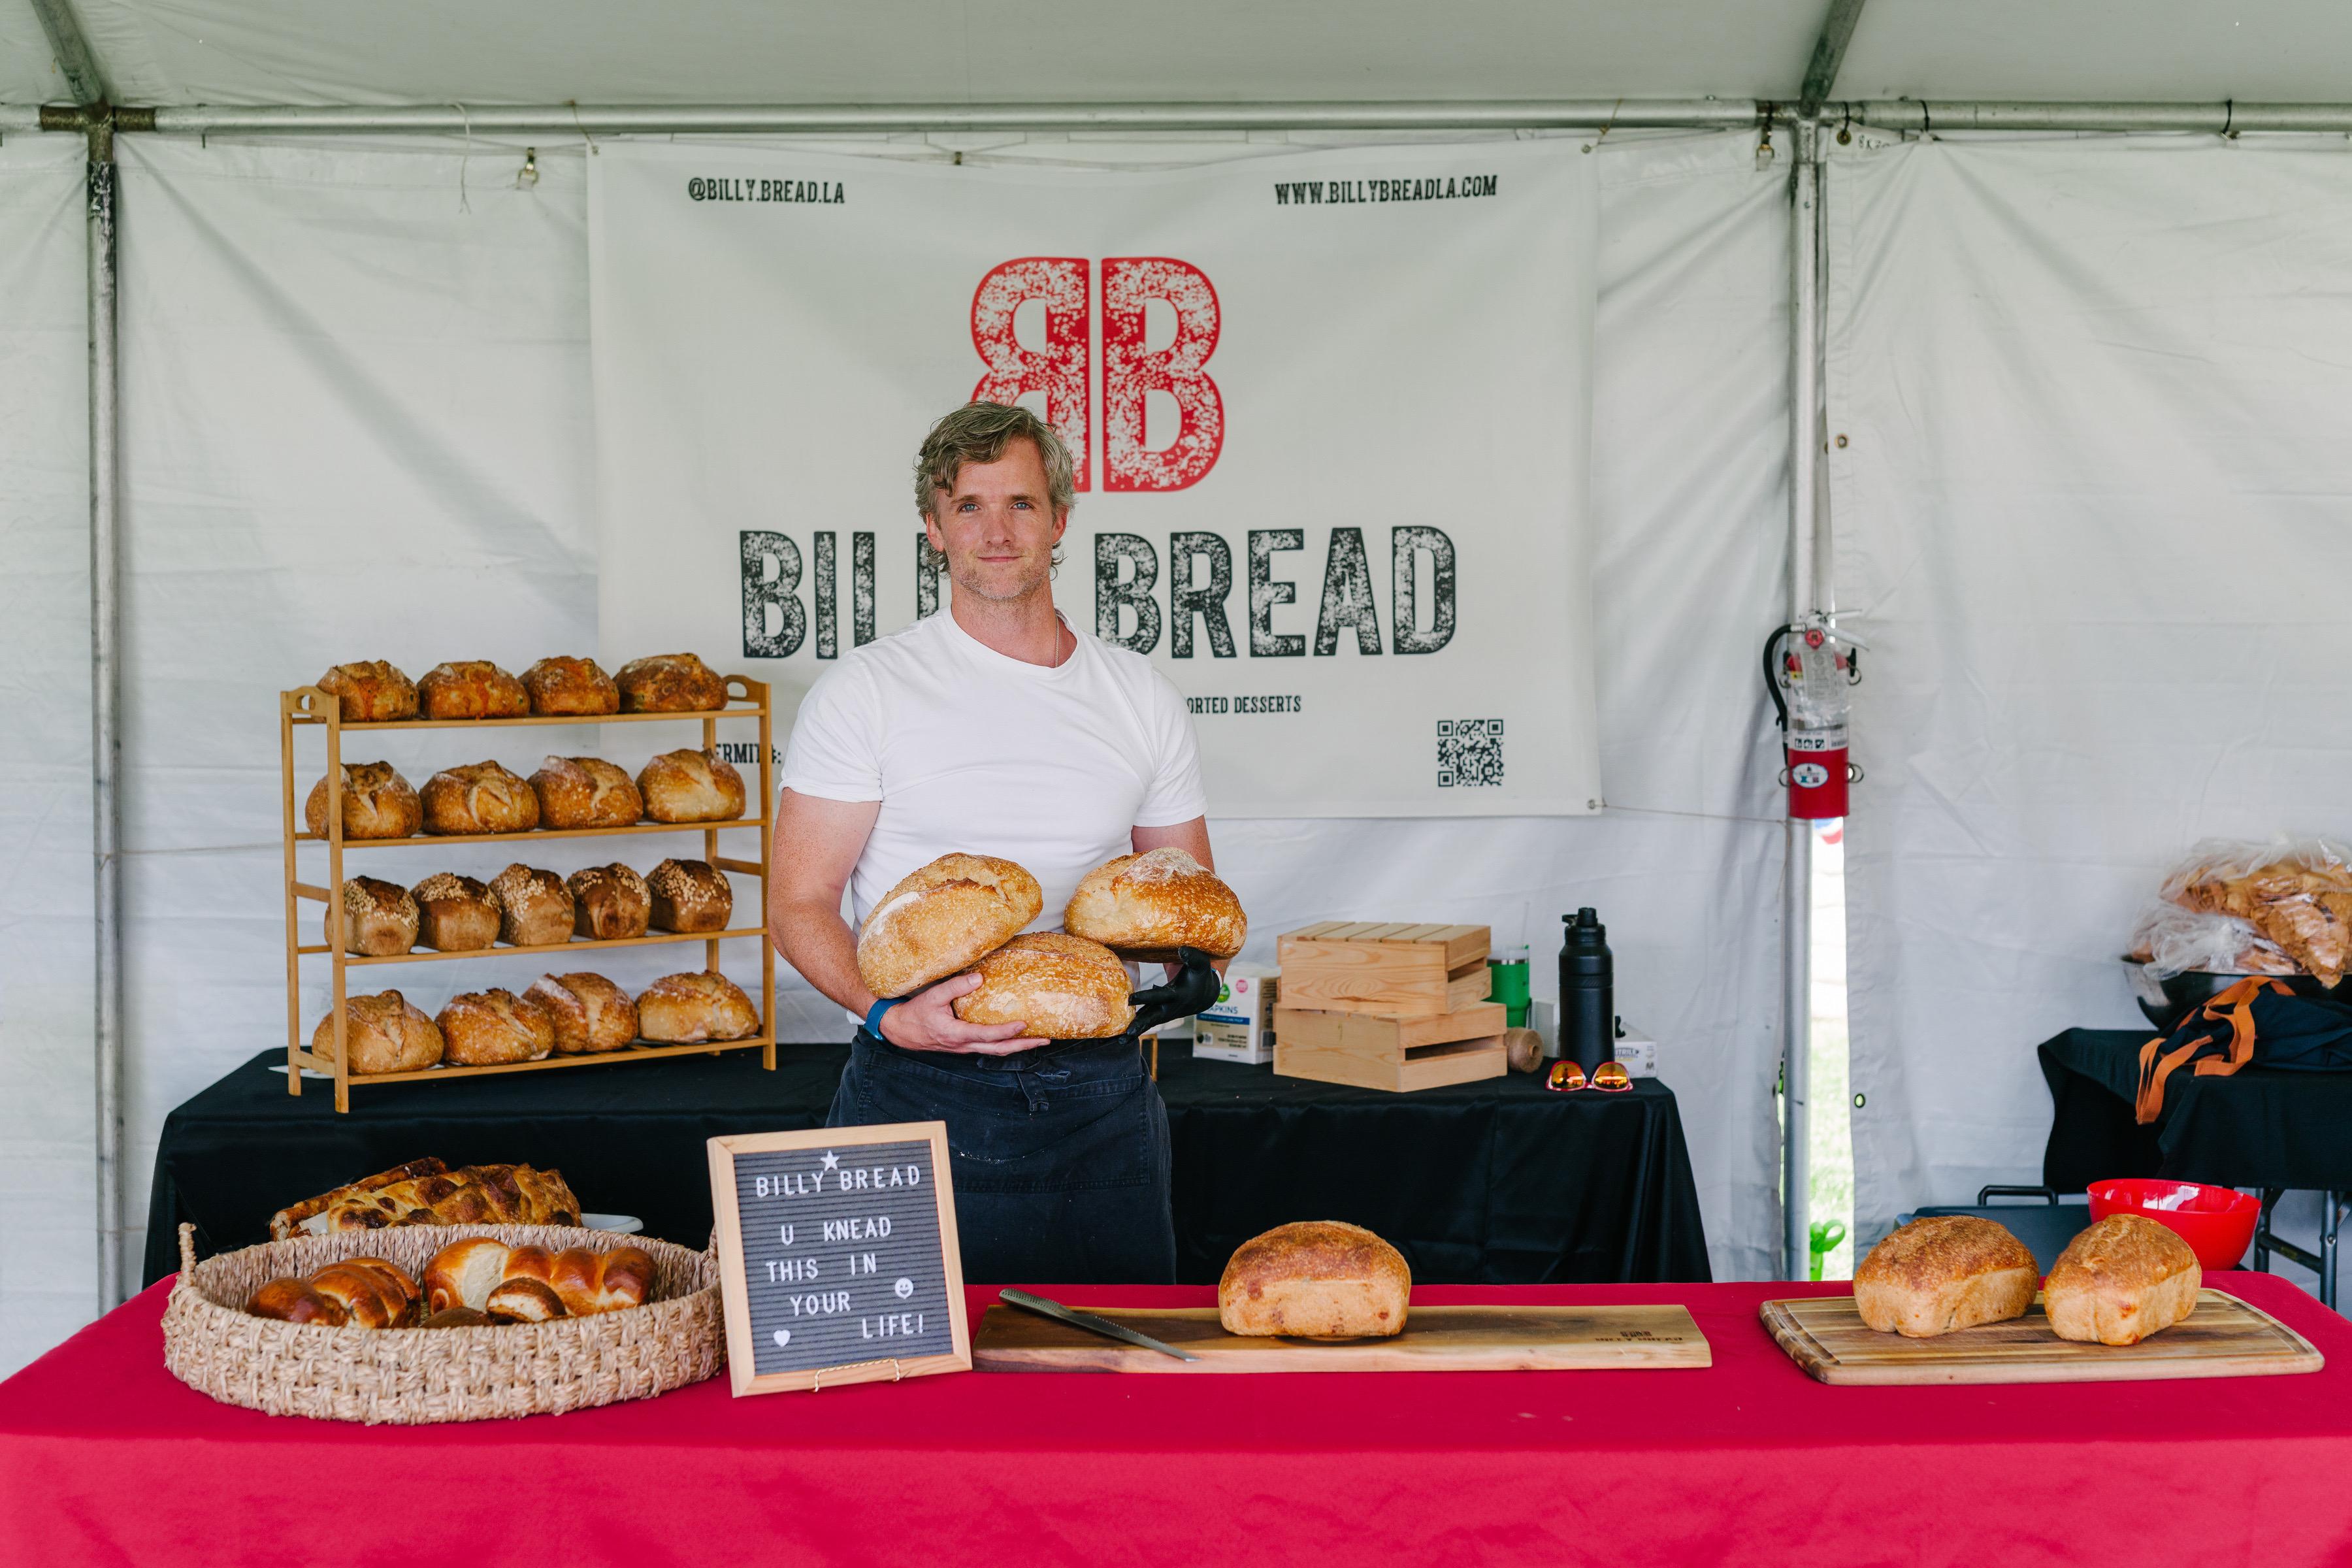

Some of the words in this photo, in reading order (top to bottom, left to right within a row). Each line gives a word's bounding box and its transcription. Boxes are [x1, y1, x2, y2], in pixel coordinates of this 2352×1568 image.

[688, 177, 845, 204] @BILLY.BREAD.LA
[1275, 175, 1497, 204] WWW.BILLYBREADLA.COM
[1095, 526, 1456, 659] BREAD
[1186, 697, 1228, 713] ORTED
[1234, 695, 1301, 713] DESSERTS
[1207, 1005, 1238, 1014] APKINS
[756, 1171, 825, 1198] BILLY
[839, 1165, 921, 1191] BREAD
[781, 1224, 794, 1245] U
[823, 1216, 892, 1241] KNEAD
[765, 1259, 819, 1282] THIS
[850, 1252, 877, 1275] IN
[789, 1291, 851, 1316] YOUR
[862, 1314, 924, 1339] LIFE!
